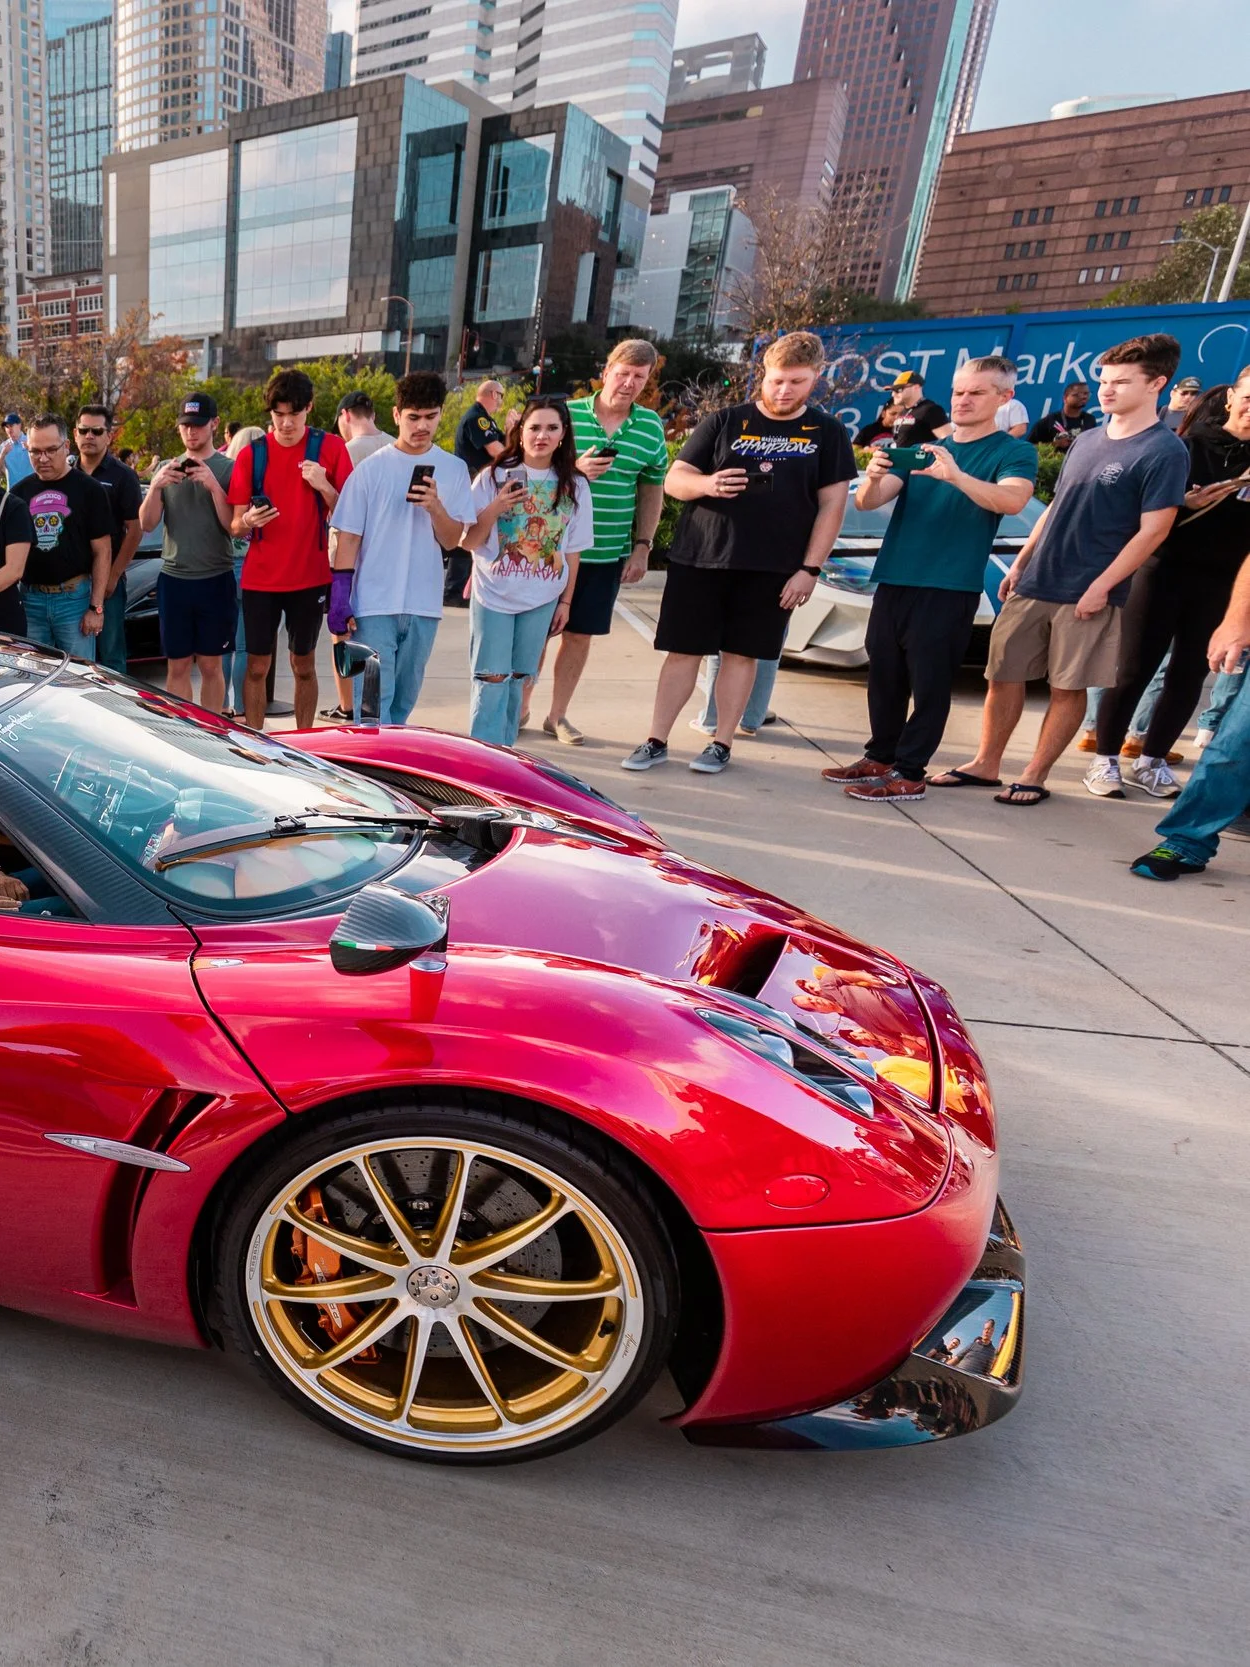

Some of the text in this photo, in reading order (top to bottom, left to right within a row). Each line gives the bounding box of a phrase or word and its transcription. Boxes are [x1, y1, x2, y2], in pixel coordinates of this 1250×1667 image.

[820, 342, 1106, 393] OST Marke
[731, 438, 818, 456] CHAMPIONS
